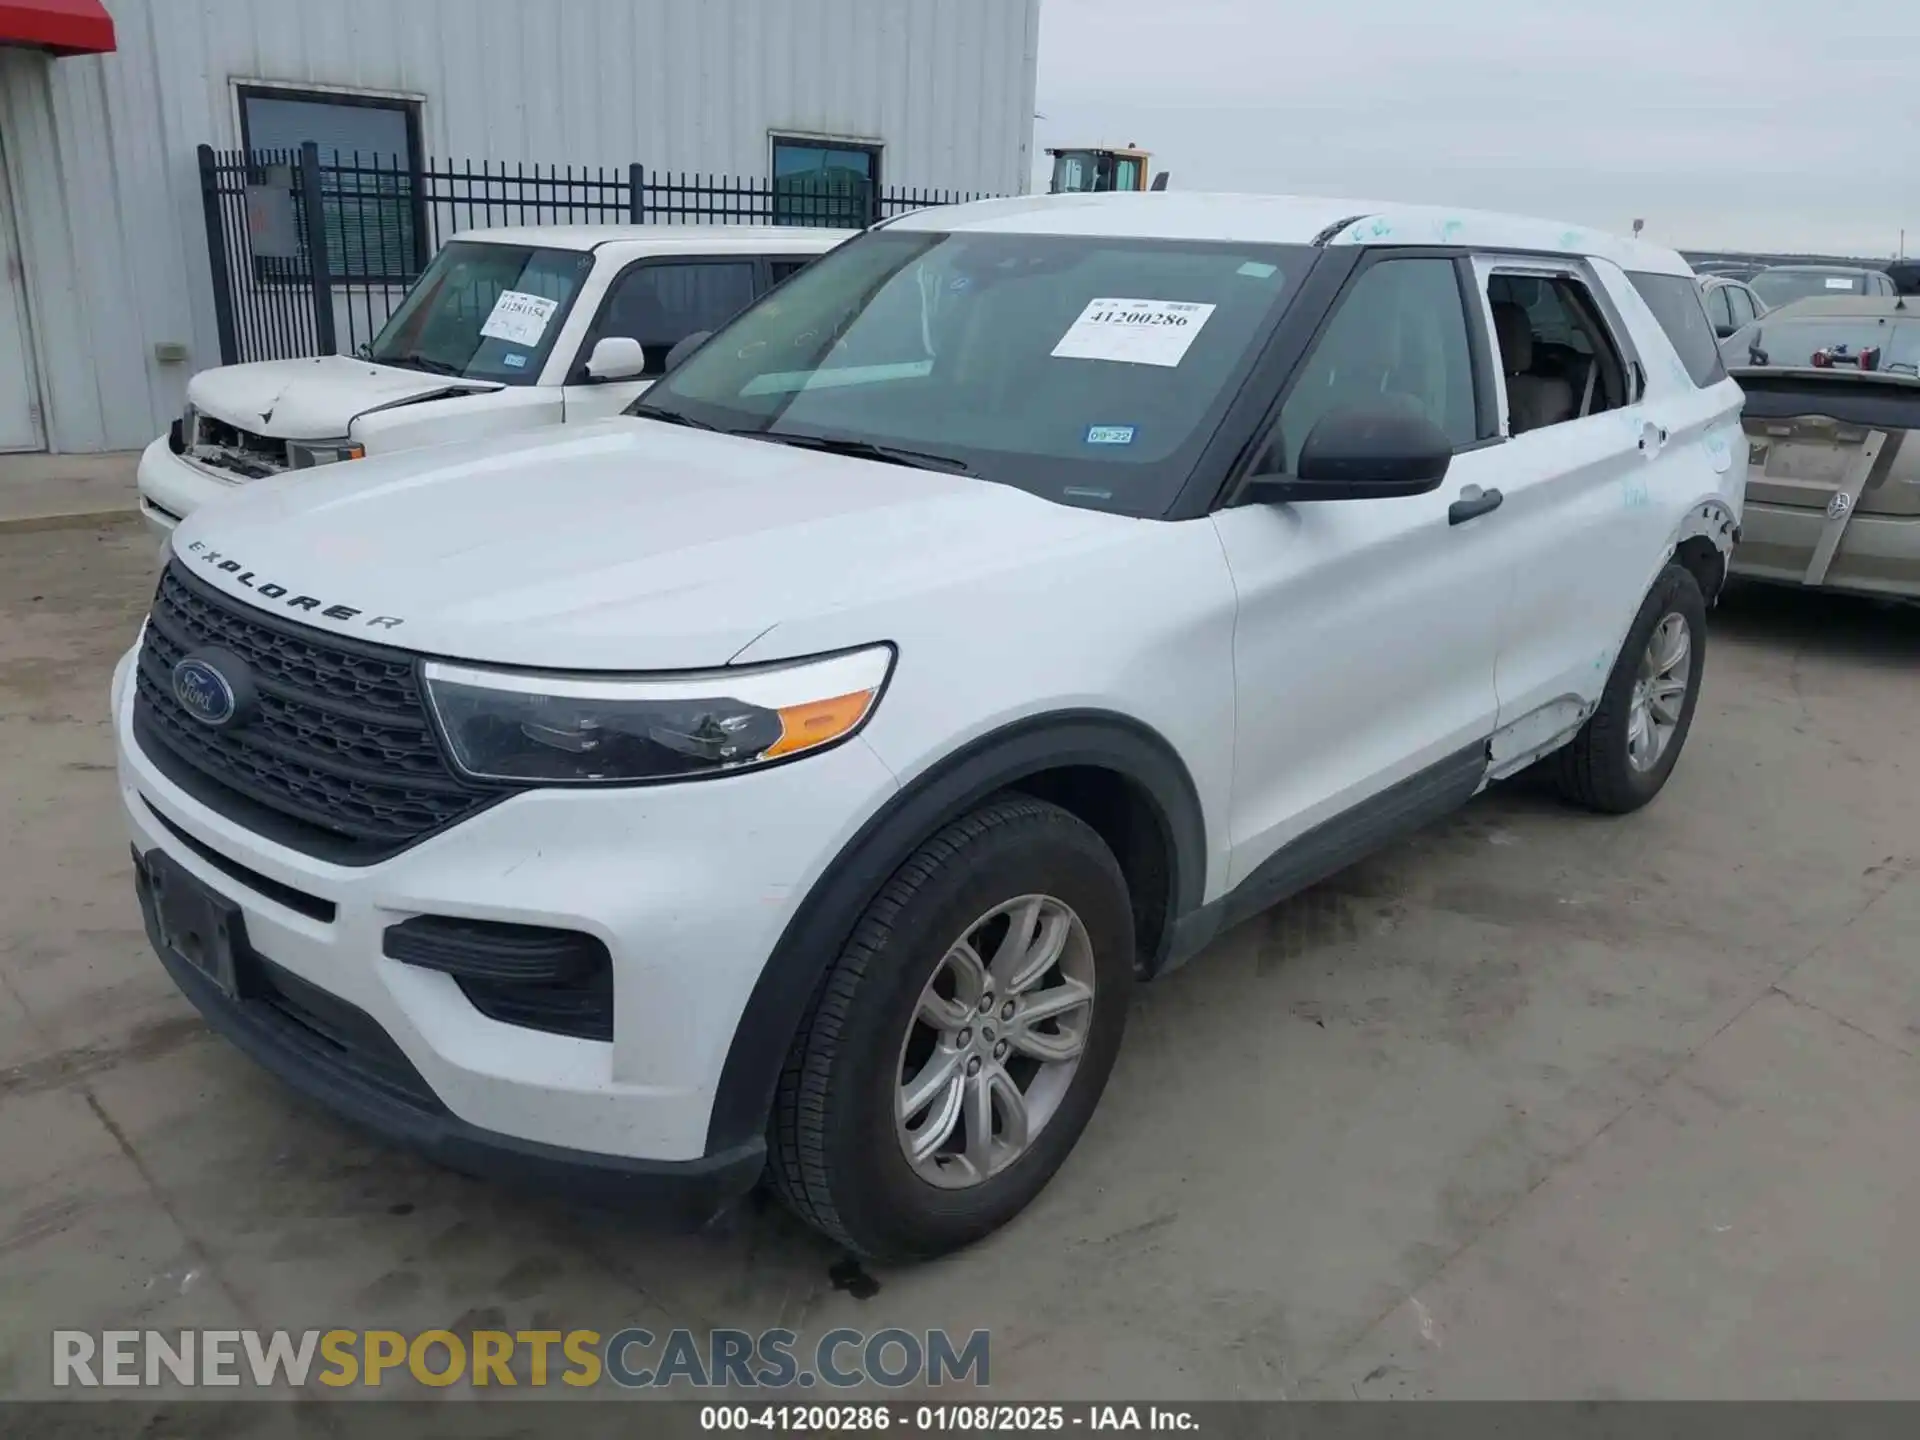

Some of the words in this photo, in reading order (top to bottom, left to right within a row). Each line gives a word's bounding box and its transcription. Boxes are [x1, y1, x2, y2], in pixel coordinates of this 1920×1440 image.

[1090, 311, 1188, 326] 41200286
[188, 540, 404, 629] EXPLORER
[180, 670, 214, 711] Ford
